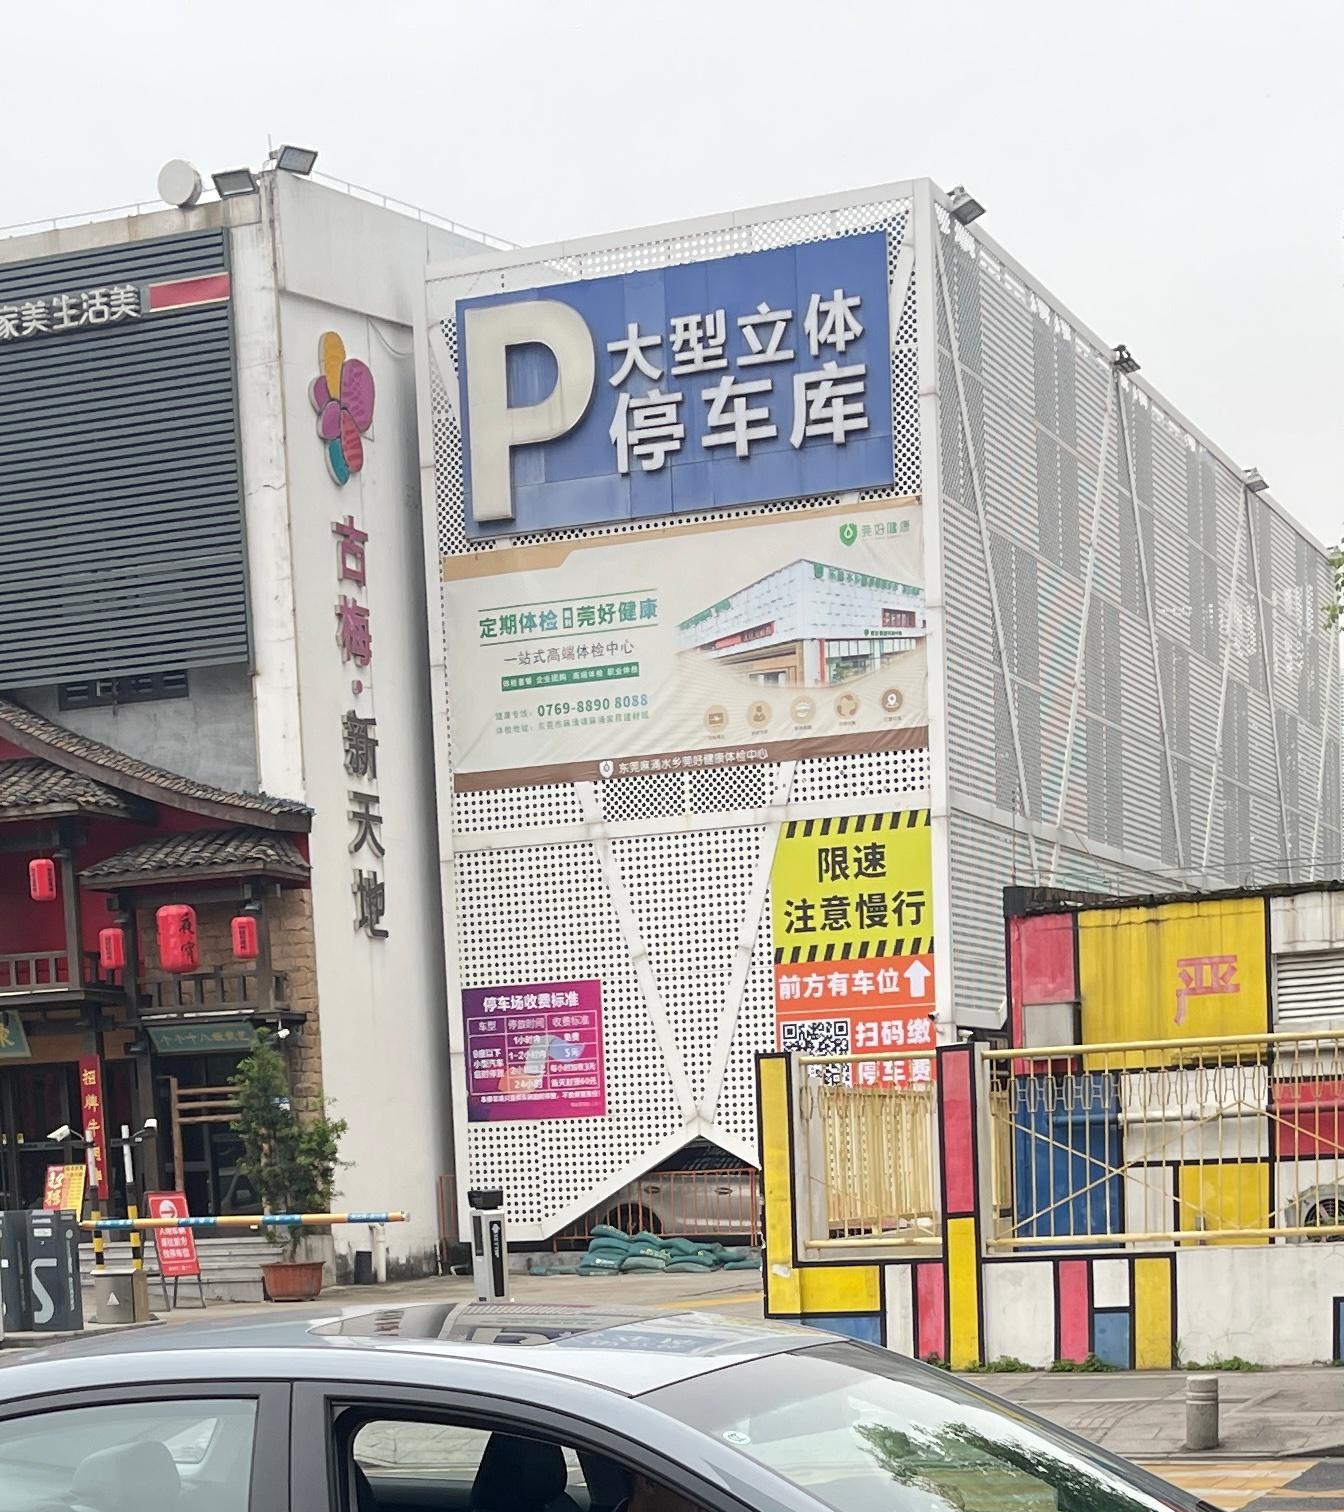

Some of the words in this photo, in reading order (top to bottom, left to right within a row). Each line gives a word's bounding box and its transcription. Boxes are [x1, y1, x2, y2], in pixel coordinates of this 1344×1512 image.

[607, 289, 864, 388] 大型立体
[464, 299, 595, 522] P
[609, 361, 869, 476] 停车库
[479, 609, 558, 638] 定期体检
[576, 598, 658, 628] 莞好健康
[504, 639, 635, 665] 一站式高端体检中心
[537, 698, 610, 717] 0769-8890
[614, 694, 648, 709] 8088
[817, 841, 887, 883] 限速
[784, 890, 926, 934] 注意慢行
[482, 990, 580, 1013] 停车场收费标准
[778, 967, 900, 1000] 前方有车位
[855, 1017, 931, 1047] 扫码缴
